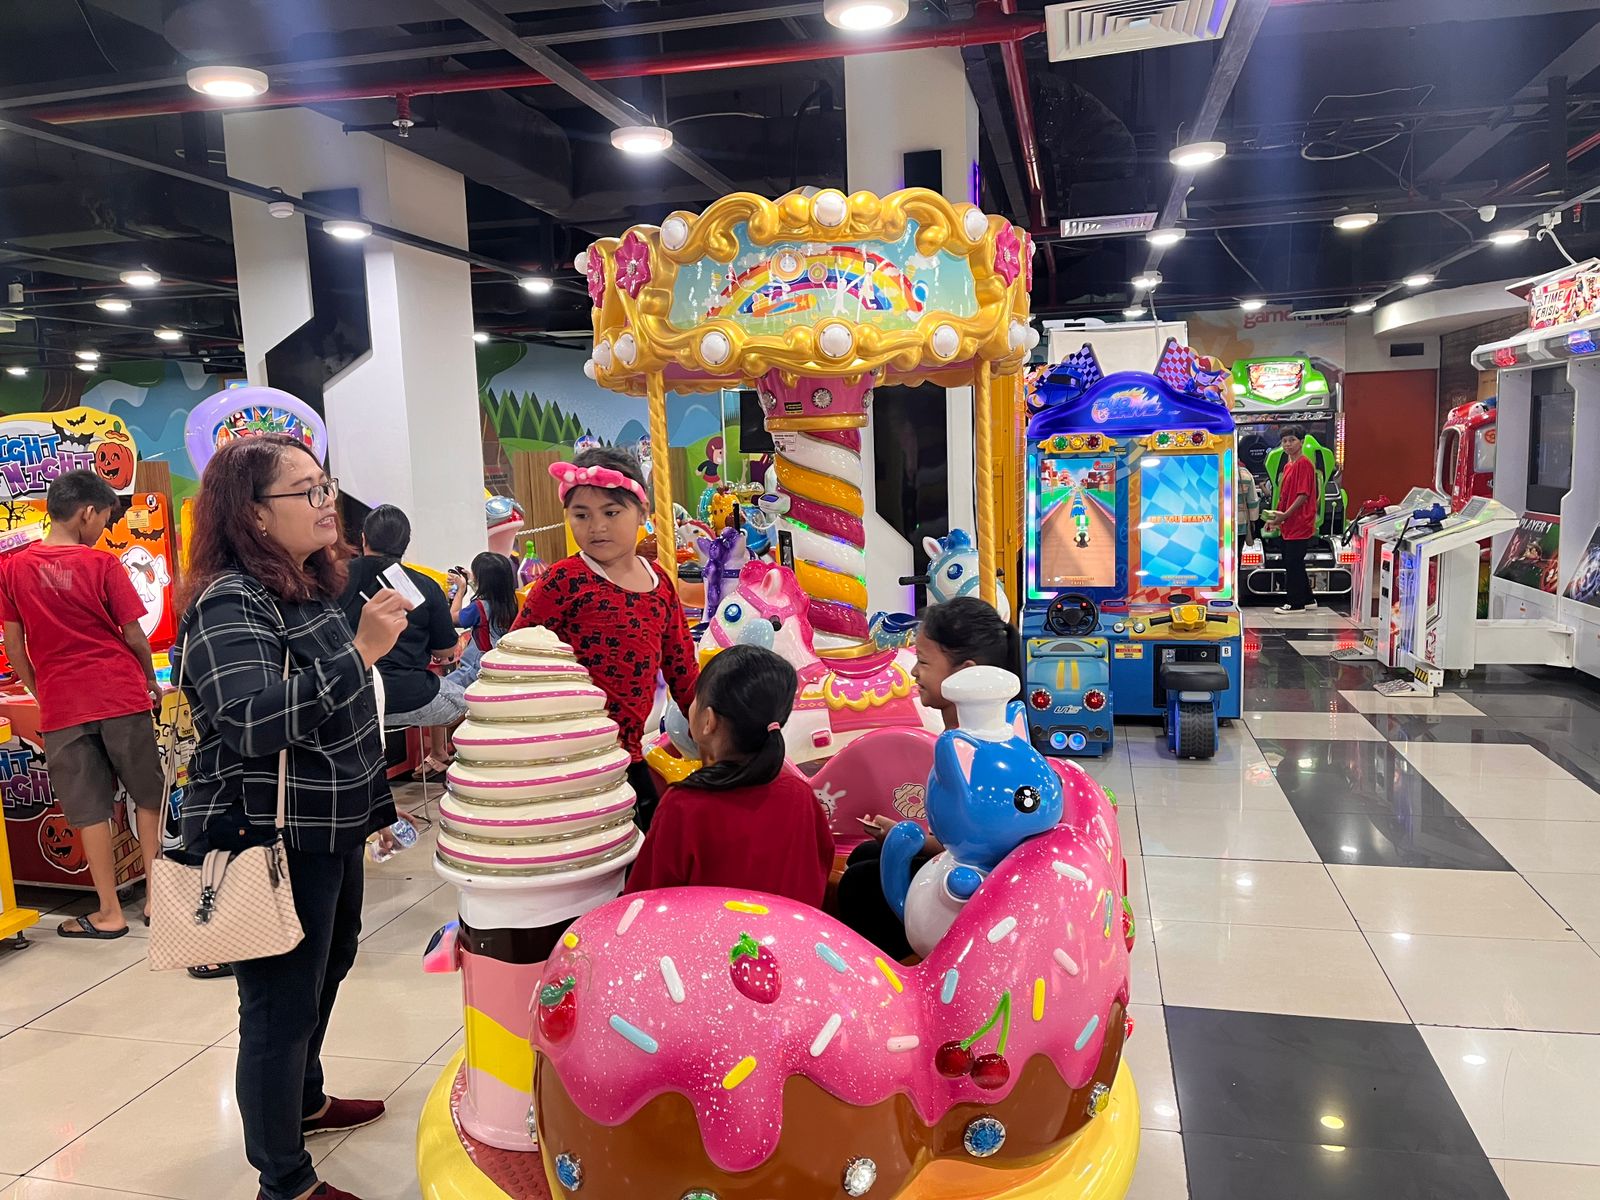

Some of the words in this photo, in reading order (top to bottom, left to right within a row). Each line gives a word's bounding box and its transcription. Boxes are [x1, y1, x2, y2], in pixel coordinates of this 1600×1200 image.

[1543, 290, 1564, 305] TIME
[1536, 304, 1560, 321] CRISIS
[0, 451, 95, 496] NIGHT
[1164, 515, 1181, 523] YOU
[1520, 518, 1547, 533] PLAYER
[1545, 522, 1552, 534] 1
